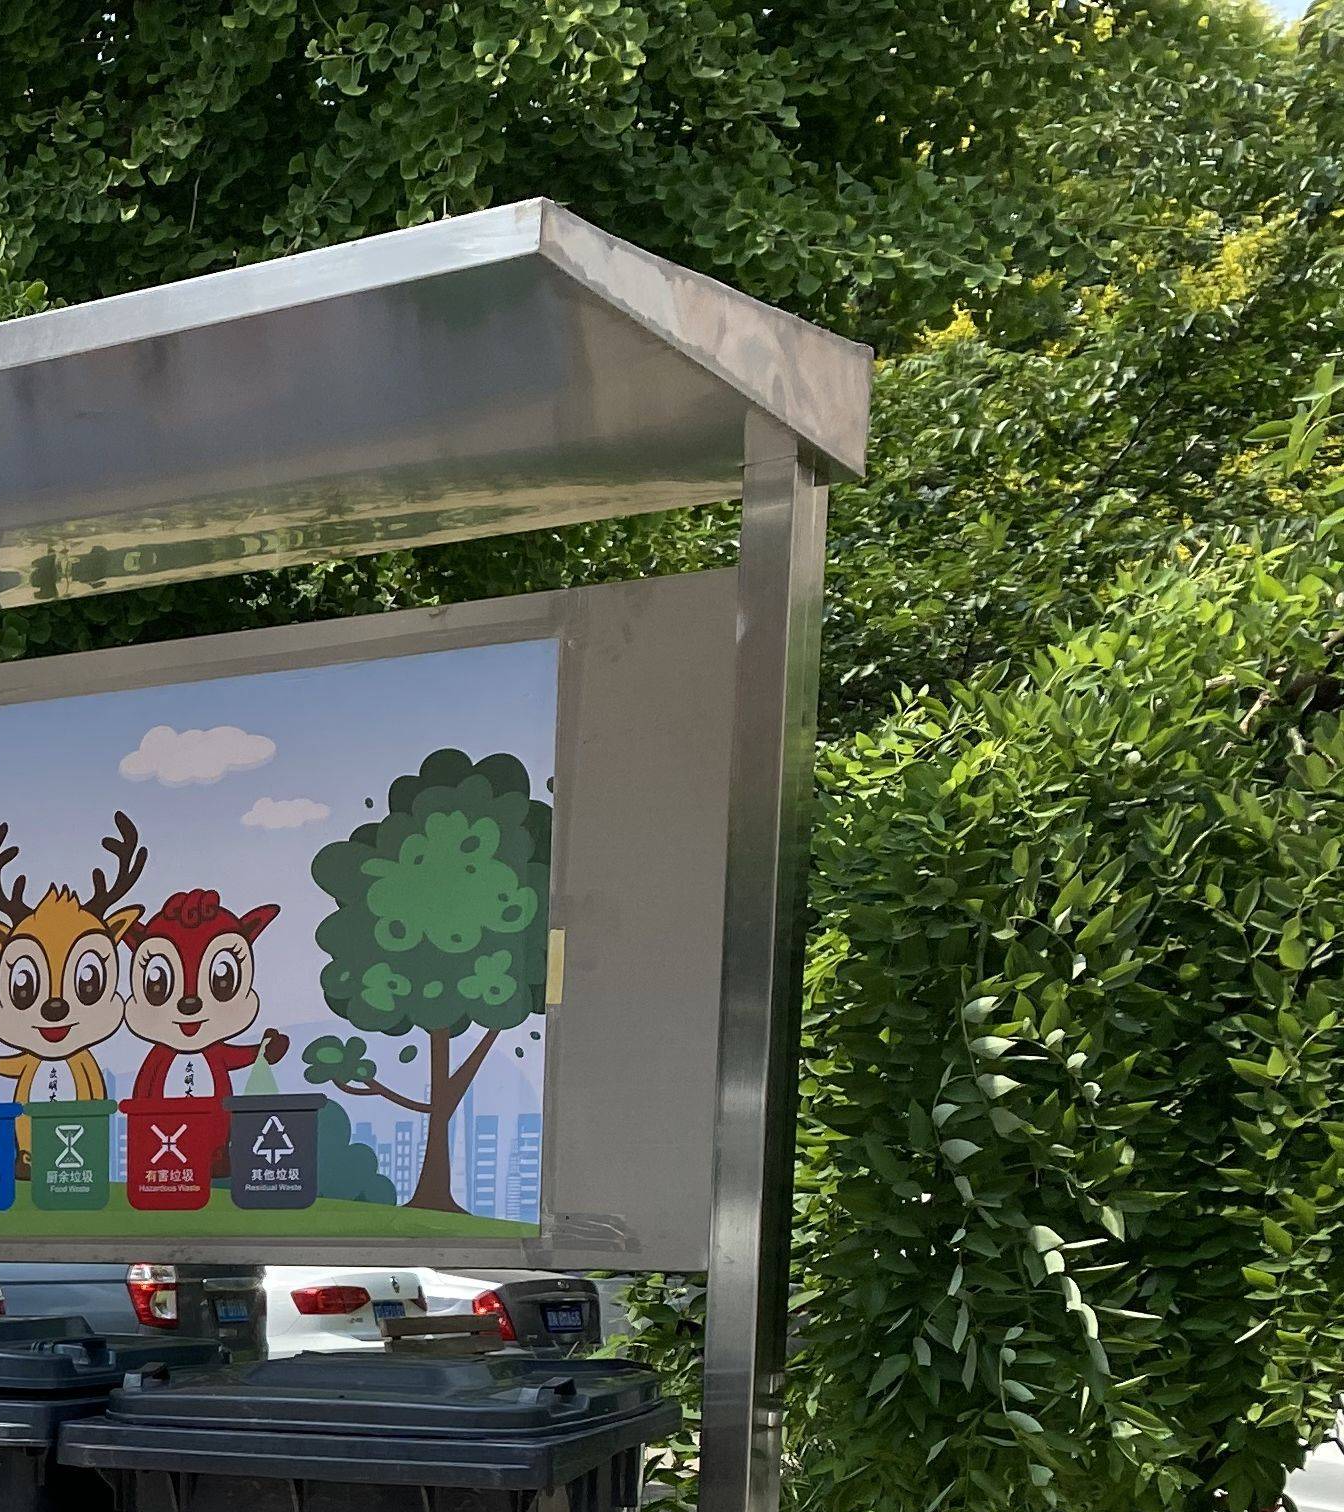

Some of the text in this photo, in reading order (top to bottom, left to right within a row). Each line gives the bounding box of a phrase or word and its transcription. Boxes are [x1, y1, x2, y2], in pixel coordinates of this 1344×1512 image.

[46, 1170, 94, 1184] 厨余垃圾
[145, 1169, 194, 1182] 有害垃圾
[251, 1168, 300, 1181] 其他垃圾
[49, 1184, 68, 1193] Food
[245, 1183, 278, 1191] Residual
